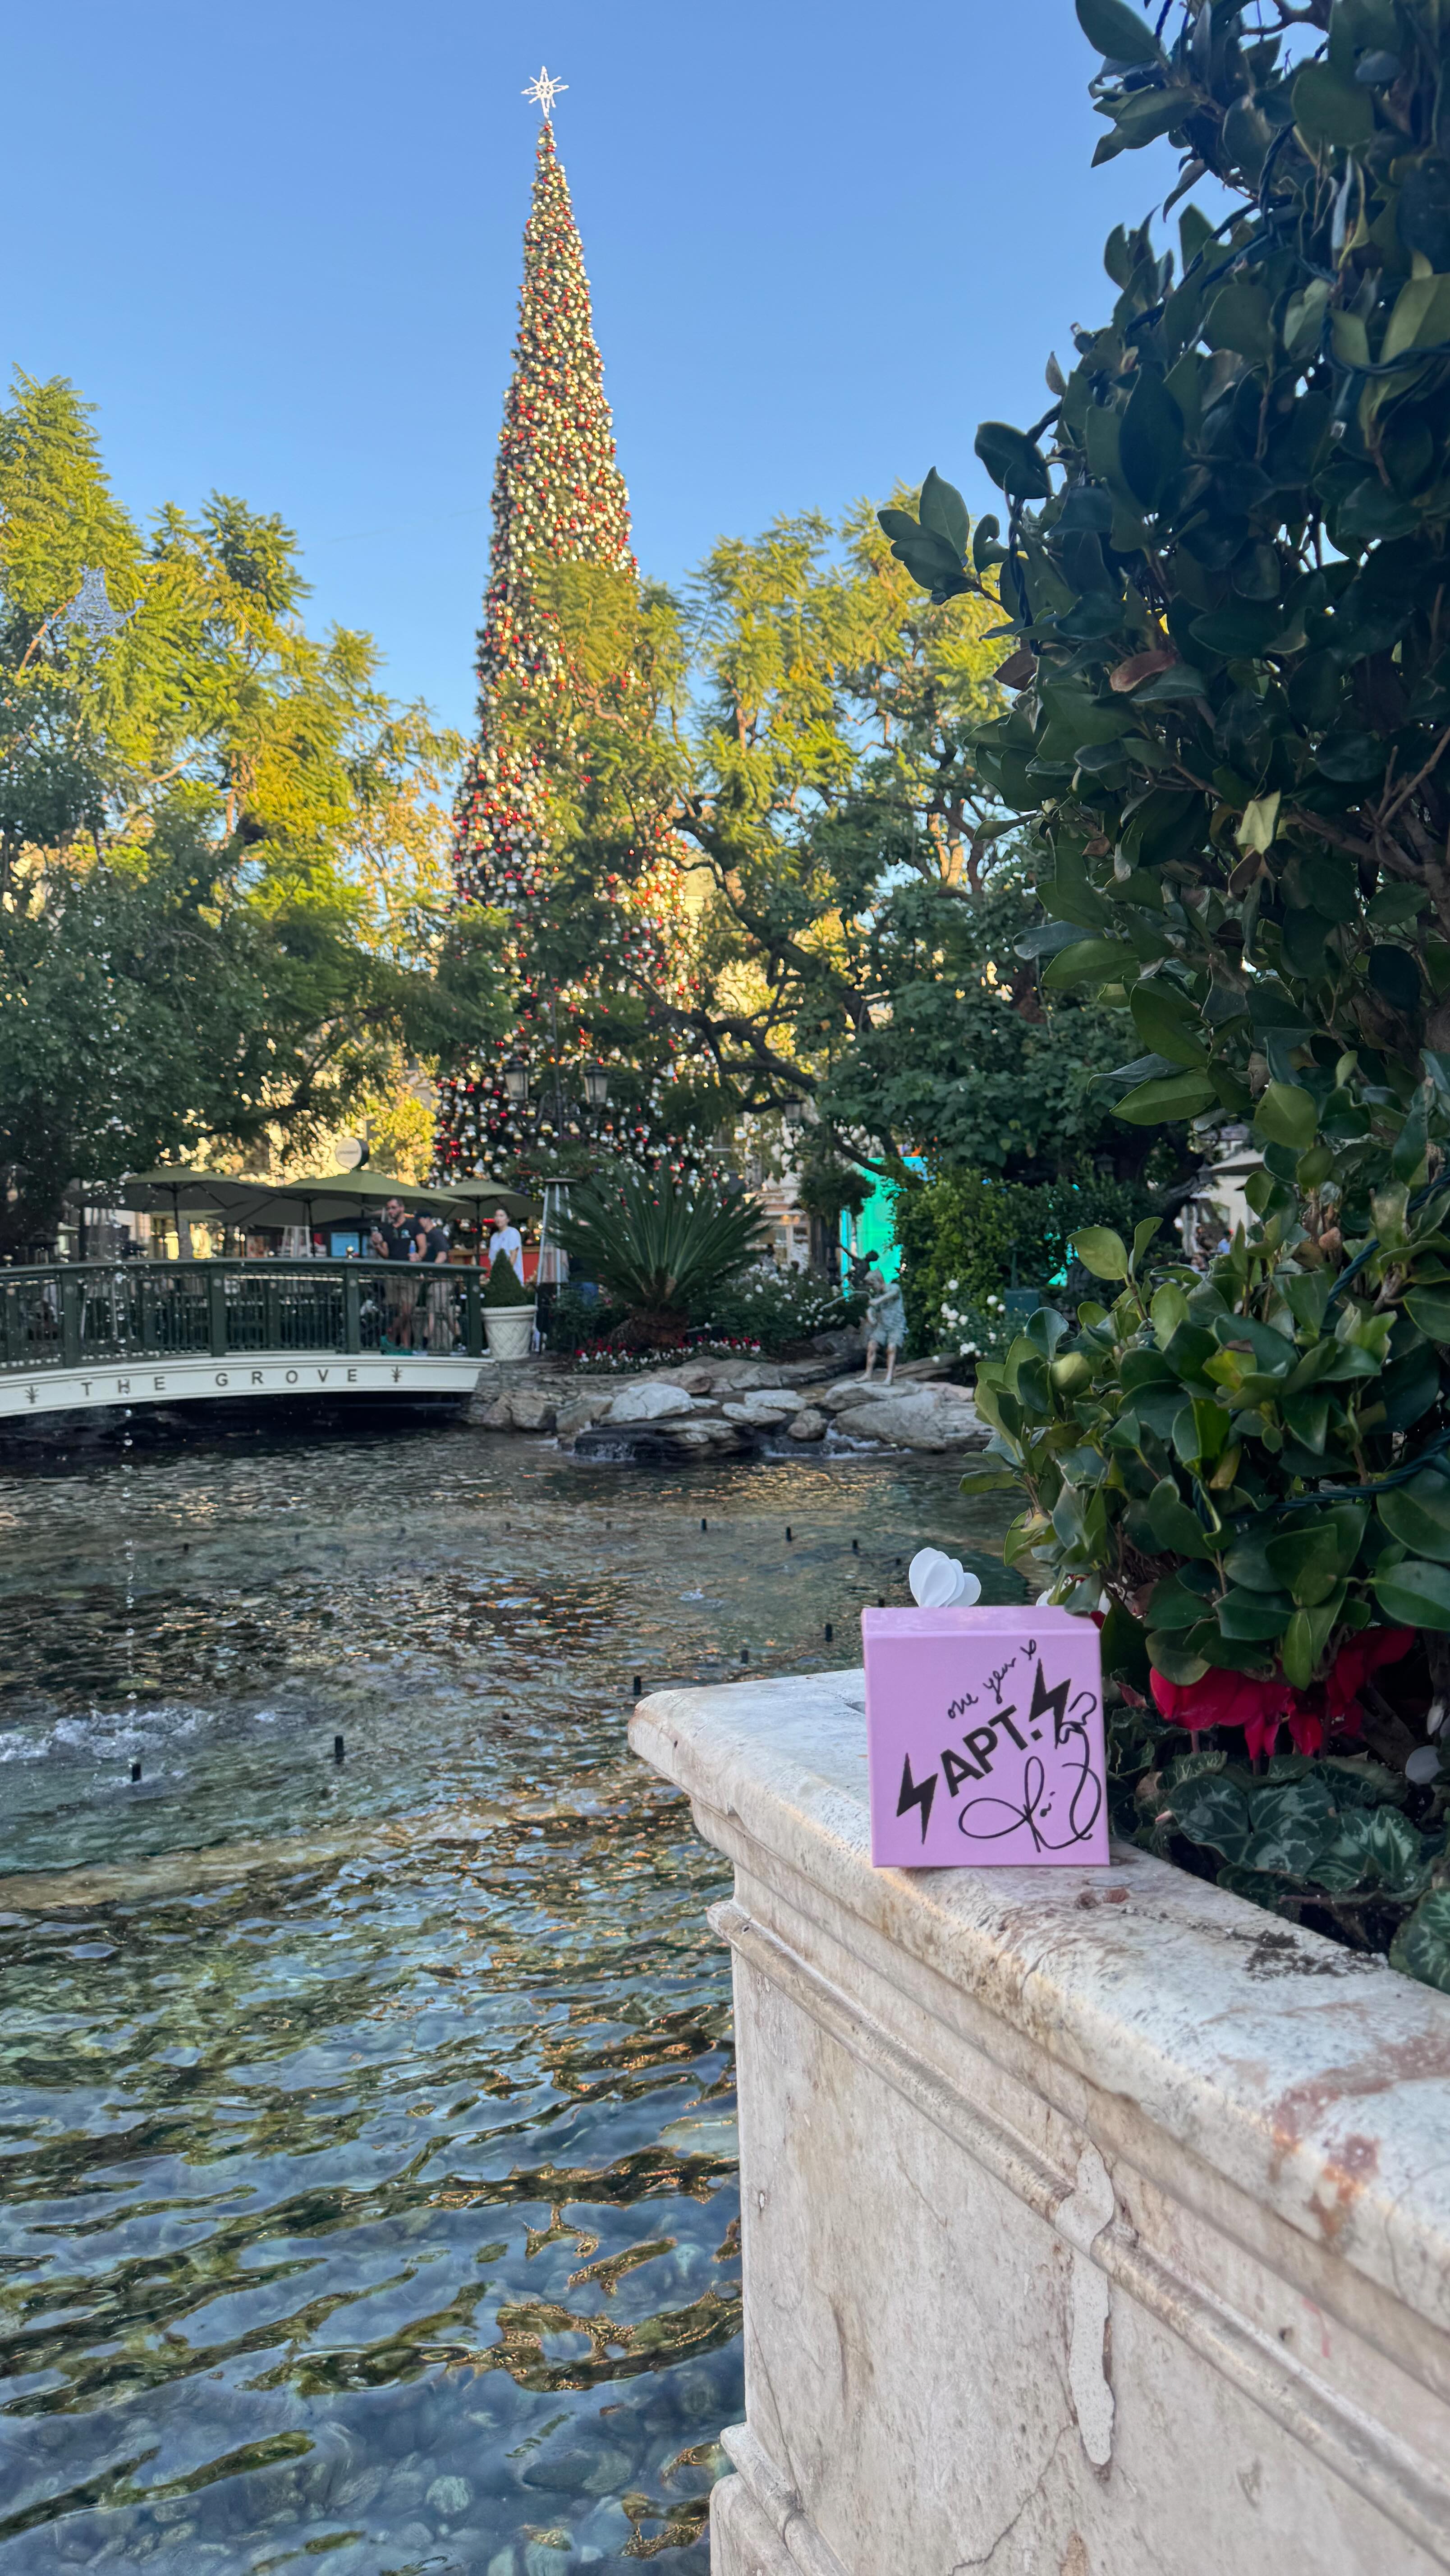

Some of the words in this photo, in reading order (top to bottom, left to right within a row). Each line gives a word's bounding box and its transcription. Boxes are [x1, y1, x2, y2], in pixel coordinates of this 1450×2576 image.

[81, 1376, 166, 1396] THE
[215, 1368, 358, 1387] GROVE
[948, 1693, 979, 1719] one
[982, 1657, 1016, 1704] year
[940, 1704, 1043, 1798] APT.
